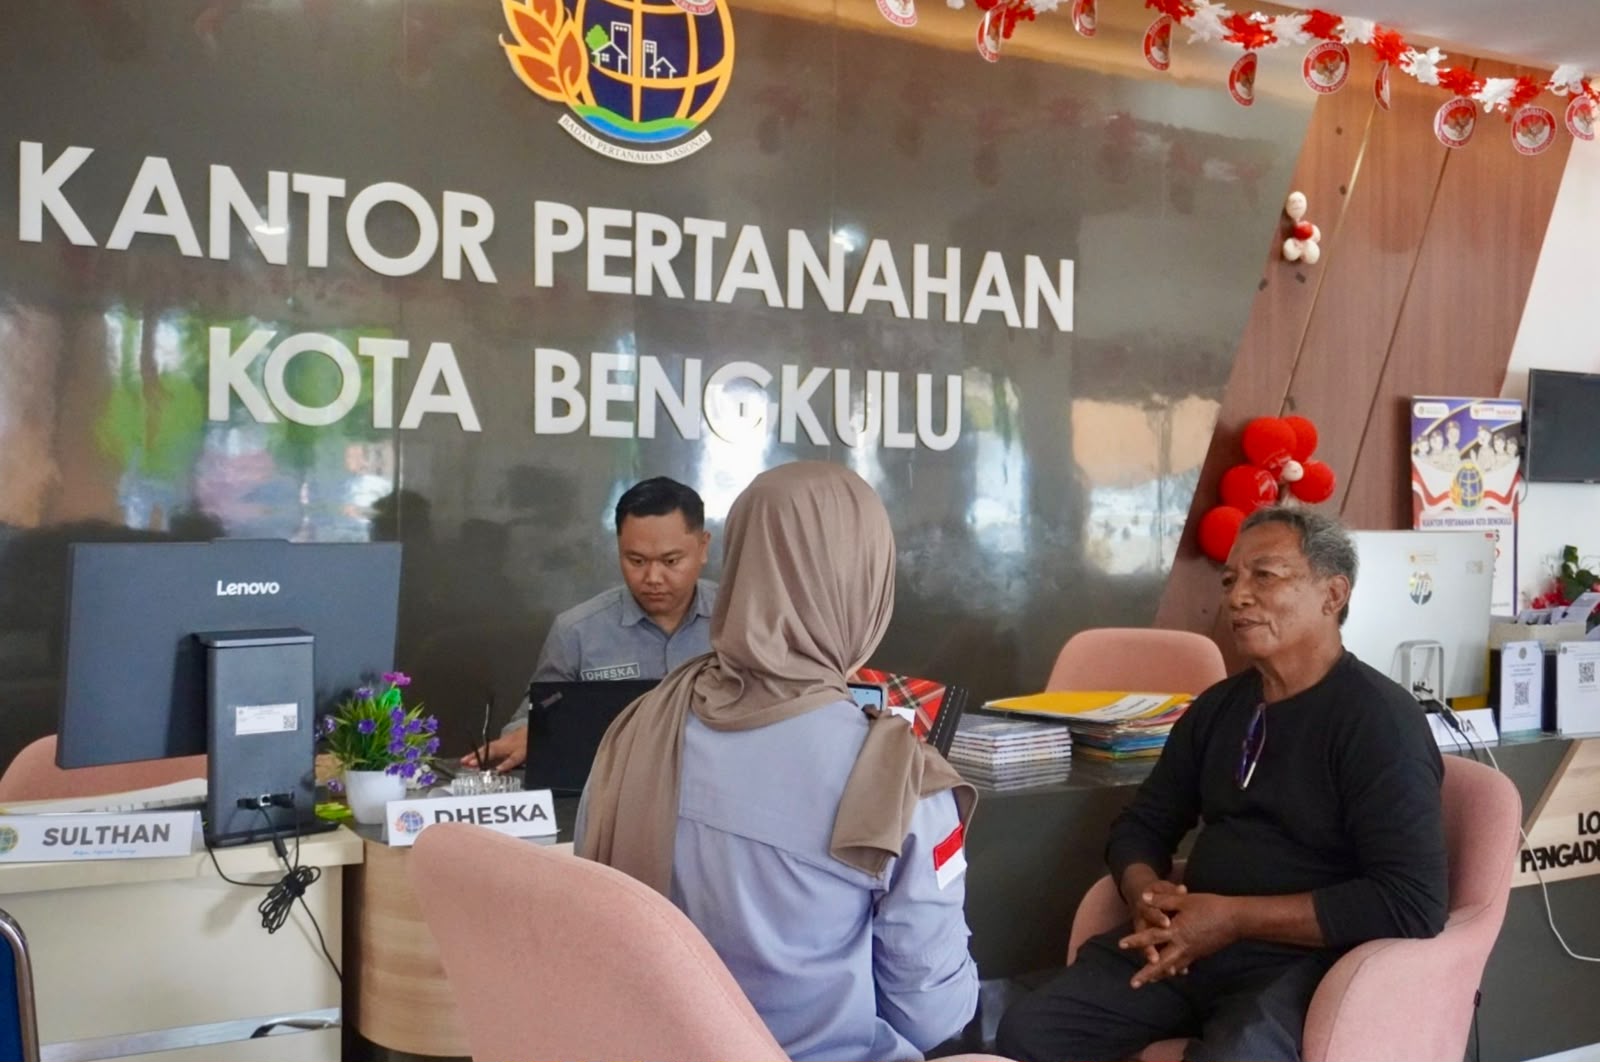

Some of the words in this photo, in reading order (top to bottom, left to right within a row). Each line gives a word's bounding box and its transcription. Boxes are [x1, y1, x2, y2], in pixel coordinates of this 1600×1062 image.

[562, 116, 594, 145] BADAN
[596, 141, 664, 162] PERTANAHAN
[661, 132, 710, 160] NASIONAL
[18, 140, 498, 284] KANTOR
[533, 200, 1075, 332] PERTANAHAN
[208, 326, 481, 433] KOTA
[533, 347, 964, 451] BENGKULU
[216, 579, 280, 596] Lenovo
[586, 666, 634, 680] DHESKA
[434, 803, 548, 825] DHESKA
[42, 823, 170, 846] SULTHAN
[1521, 839, 1600, 873] PENGAD
